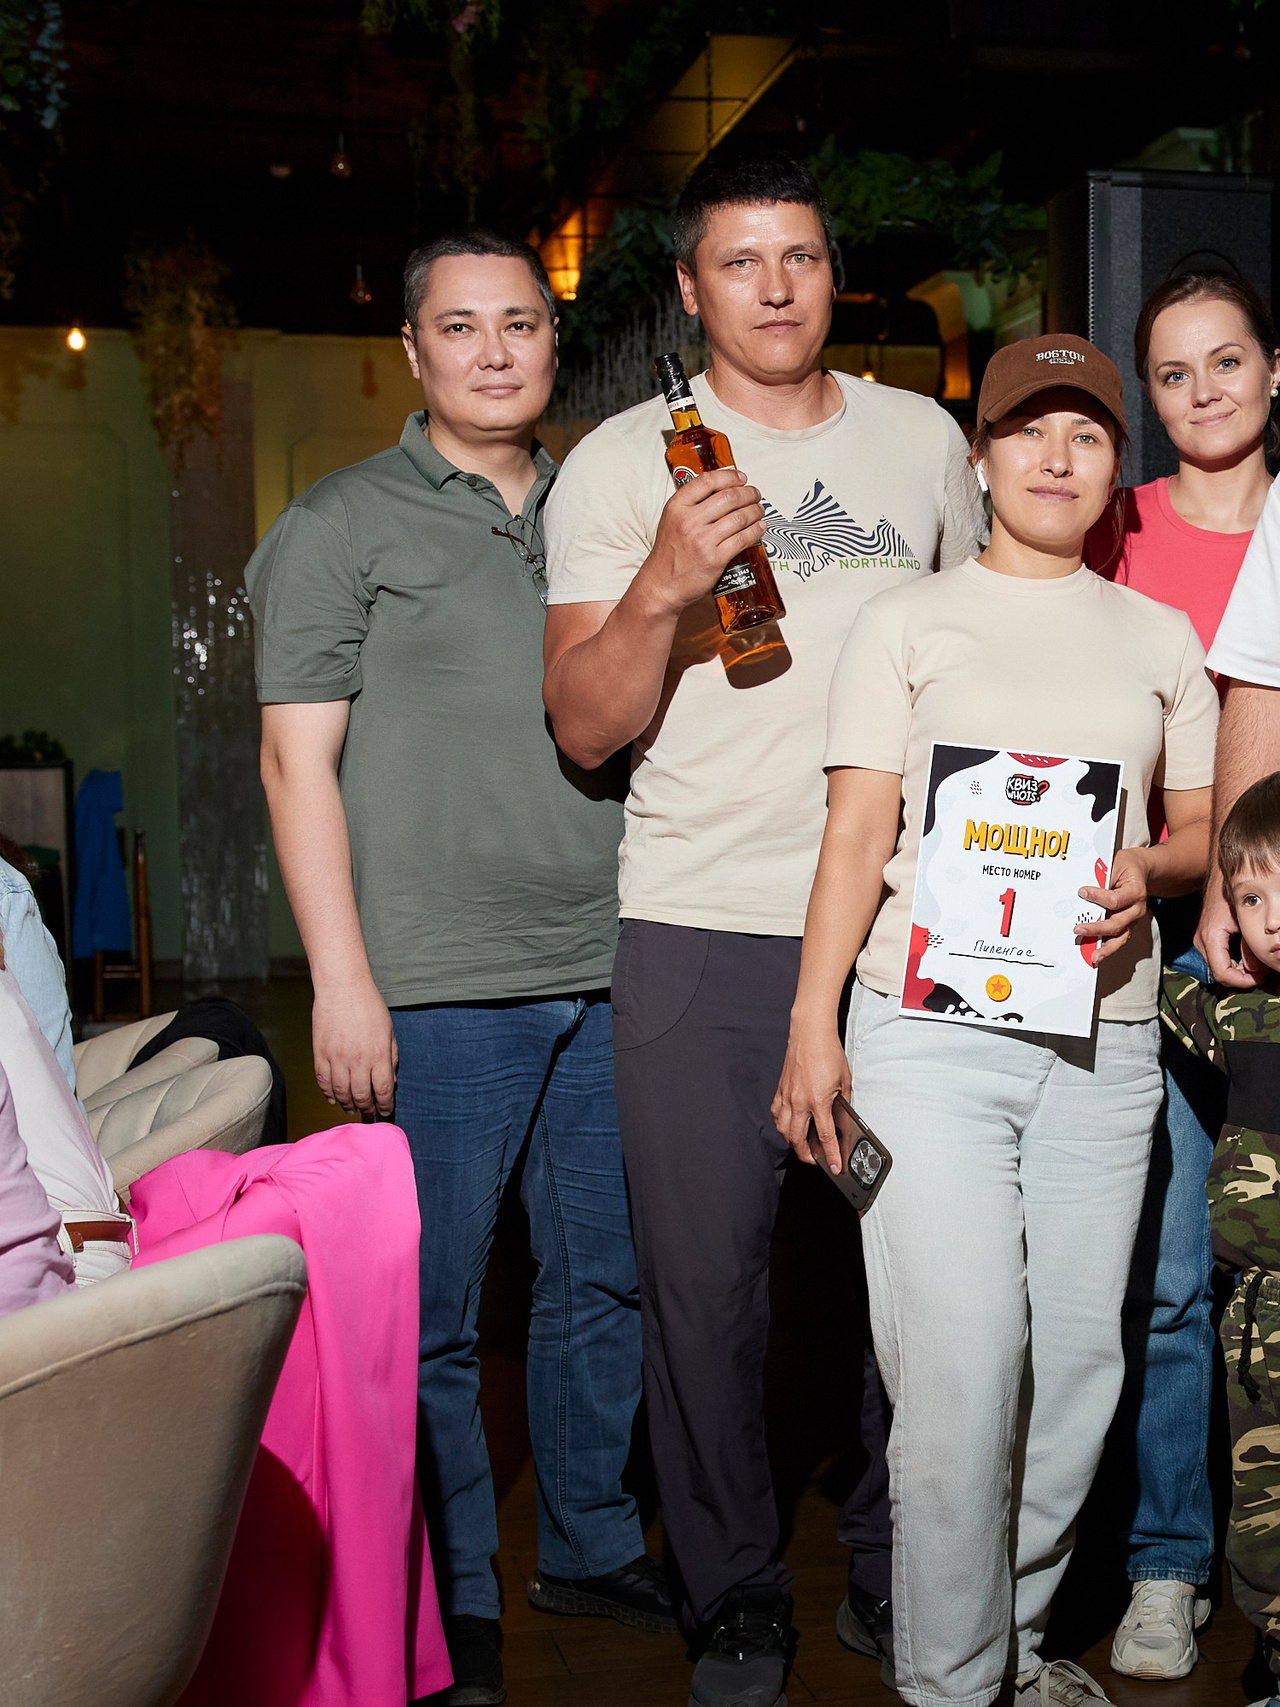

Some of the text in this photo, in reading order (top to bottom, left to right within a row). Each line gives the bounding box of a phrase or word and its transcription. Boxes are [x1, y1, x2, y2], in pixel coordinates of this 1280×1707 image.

[1036, 349, 1085, 363] BOSTON
[792, 551, 835, 583] YOUR
[839, 558, 921, 571] NORTHLAND
[1007, 777, 1038, 791] КВИЗ
[963, 819, 1070, 860] МОЩНО!
[982, 864, 1041, 881] МЕСТО НОМЕР
[999, 887, 1017, 938] 1
